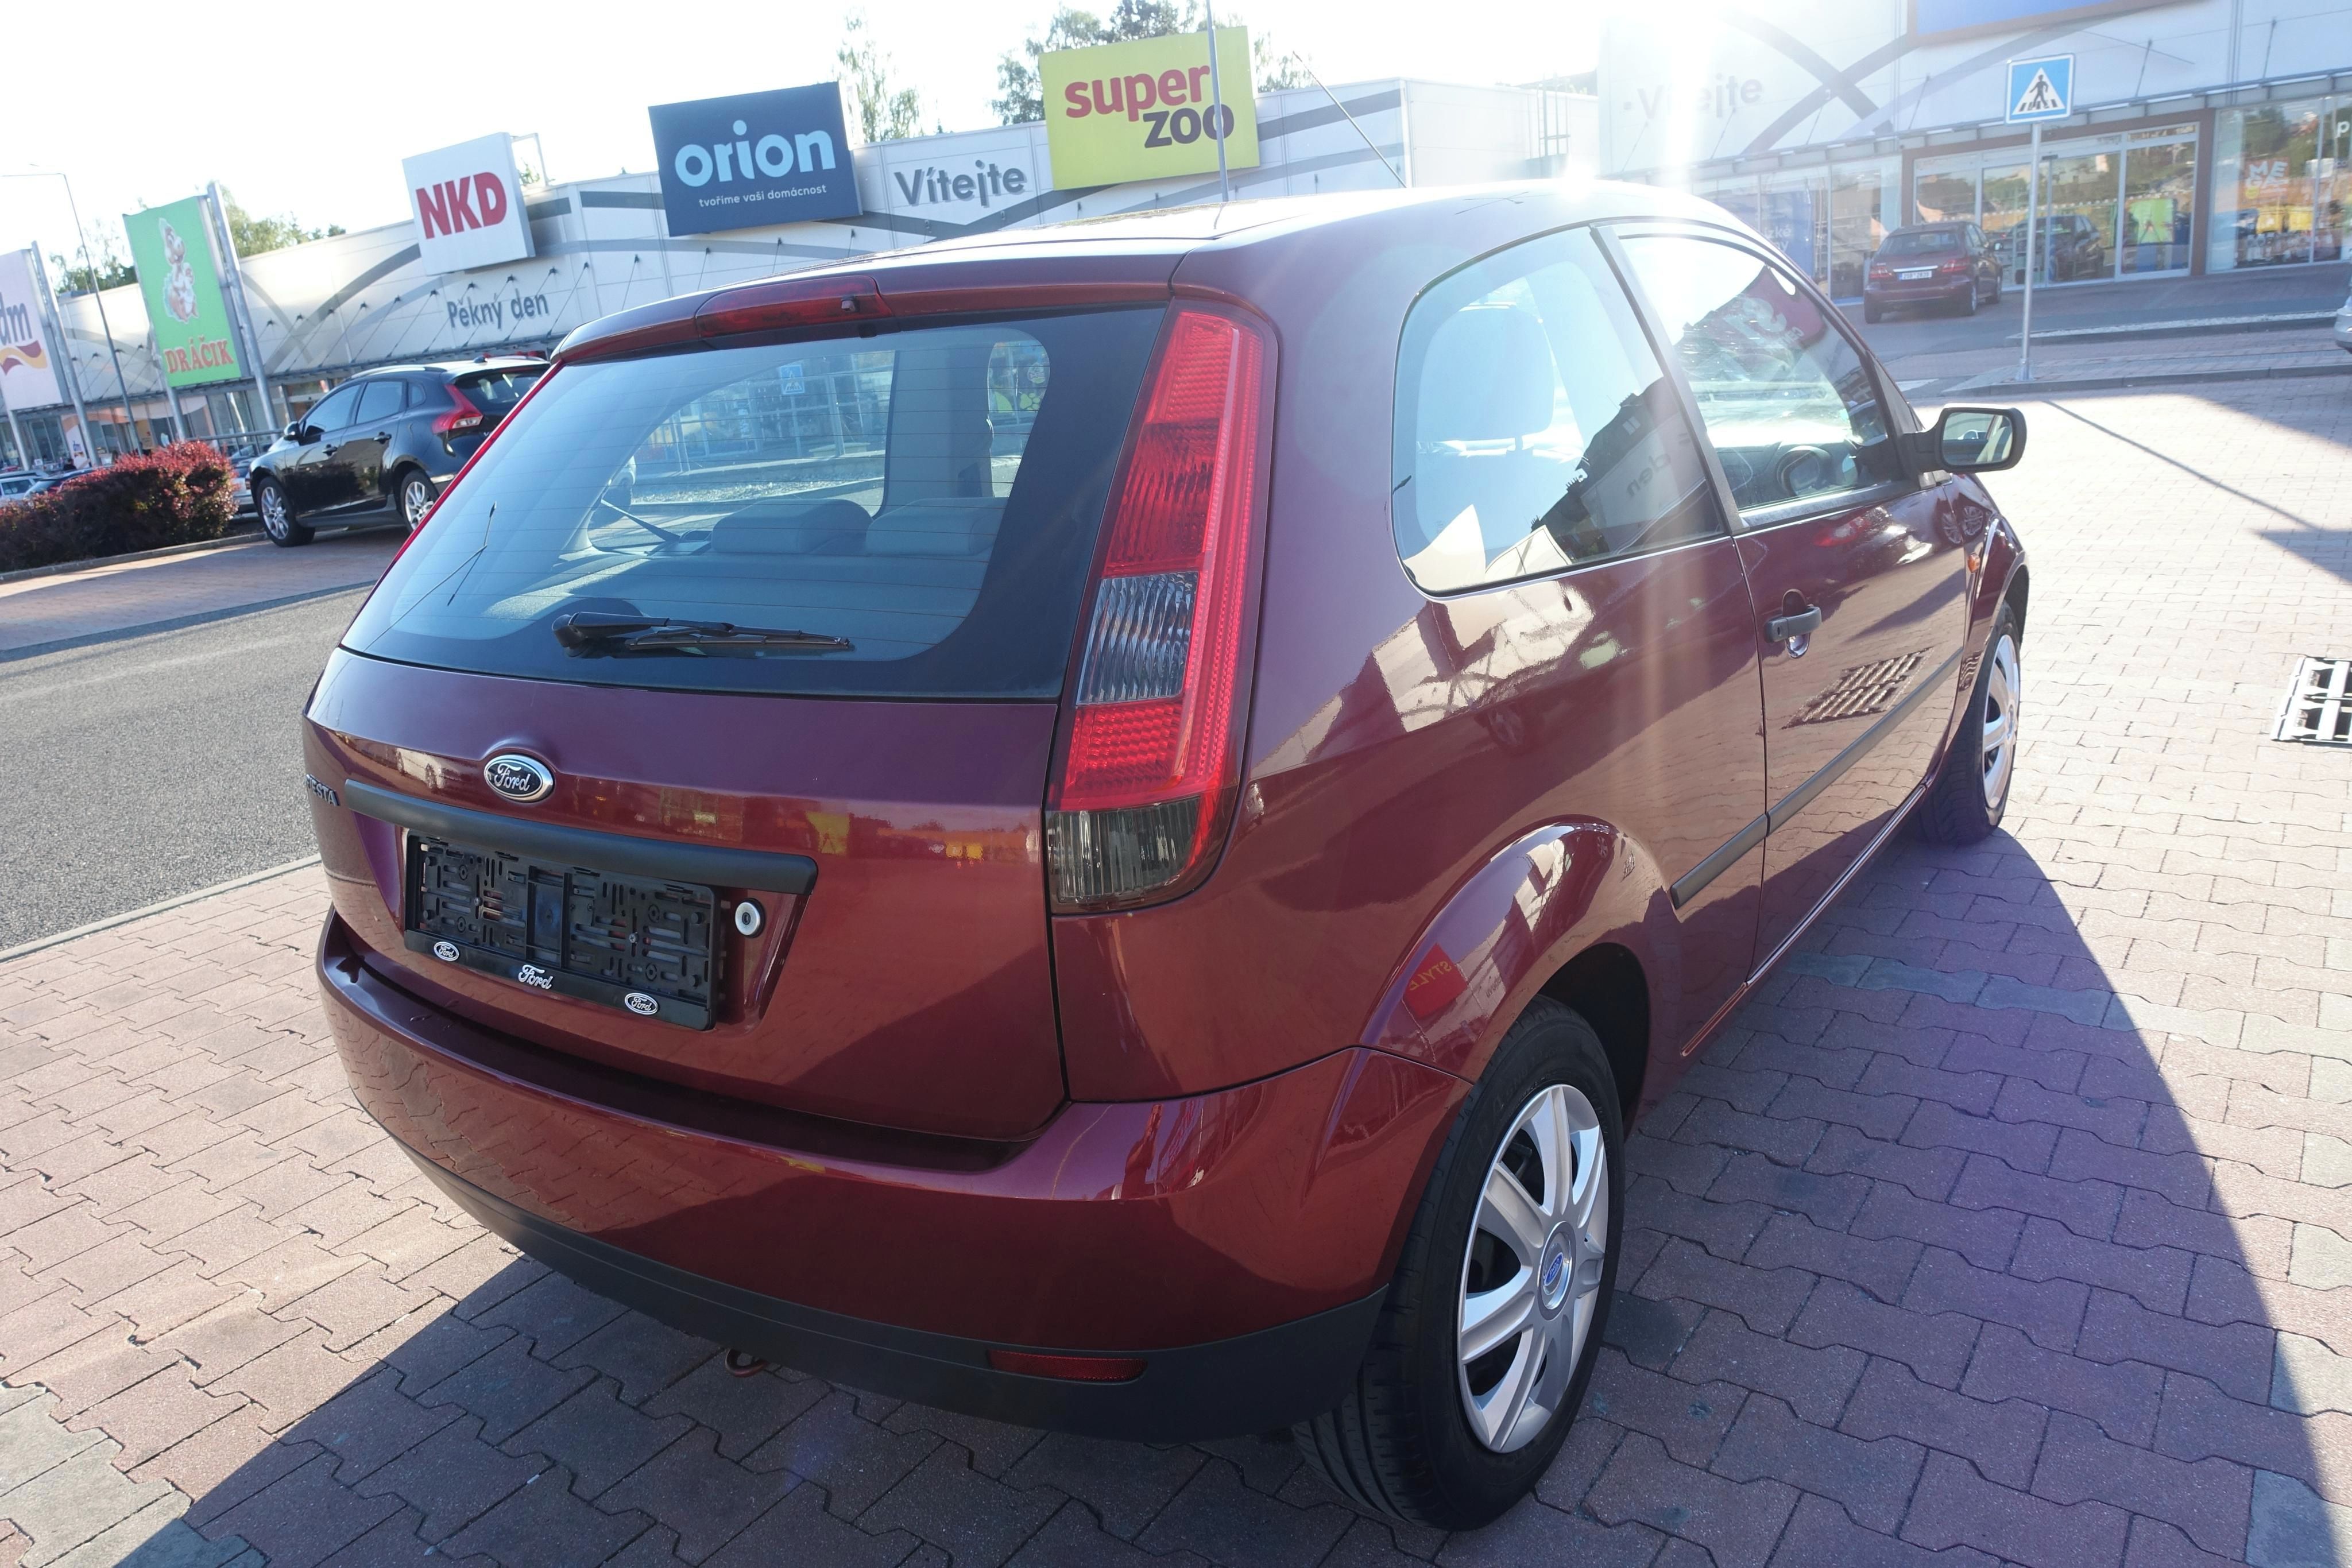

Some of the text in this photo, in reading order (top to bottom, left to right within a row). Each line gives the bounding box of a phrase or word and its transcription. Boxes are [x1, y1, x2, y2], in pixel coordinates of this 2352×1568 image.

[1065, 65, 1210, 122] super
[1143, 102, 1235, 149] zoo
[675, 119, 836, 188] orion
[699, 184, 827, 208] tvoříme vaši domácnost
[893, 160, 1027, 207] Vítejte
[415, 171, 508, 240] NKD
[447, 291, 550, 331] Pěkný den
[165, 335, 234, 374] DRÁČIK
[494, 764, 531, 791] Ford
[519, 964, 554, 990] Ford
